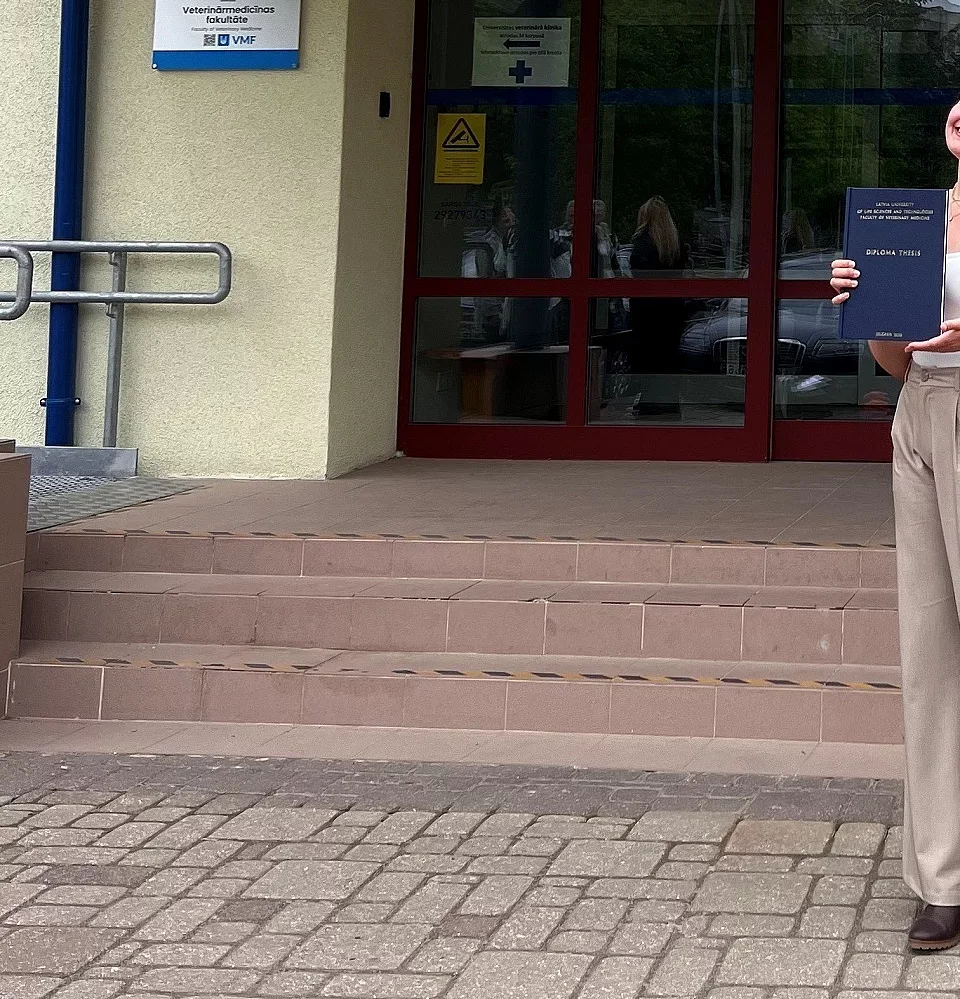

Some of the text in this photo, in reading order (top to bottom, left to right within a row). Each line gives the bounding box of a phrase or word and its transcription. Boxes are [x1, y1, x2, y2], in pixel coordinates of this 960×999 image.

[182, 5, 275, 14] Veterinārmedicīnas
[206, 15, 249, 24] fakultāte
[232, 35, 257, 44] VMF
[898, 249, 921, 257] THESIS
